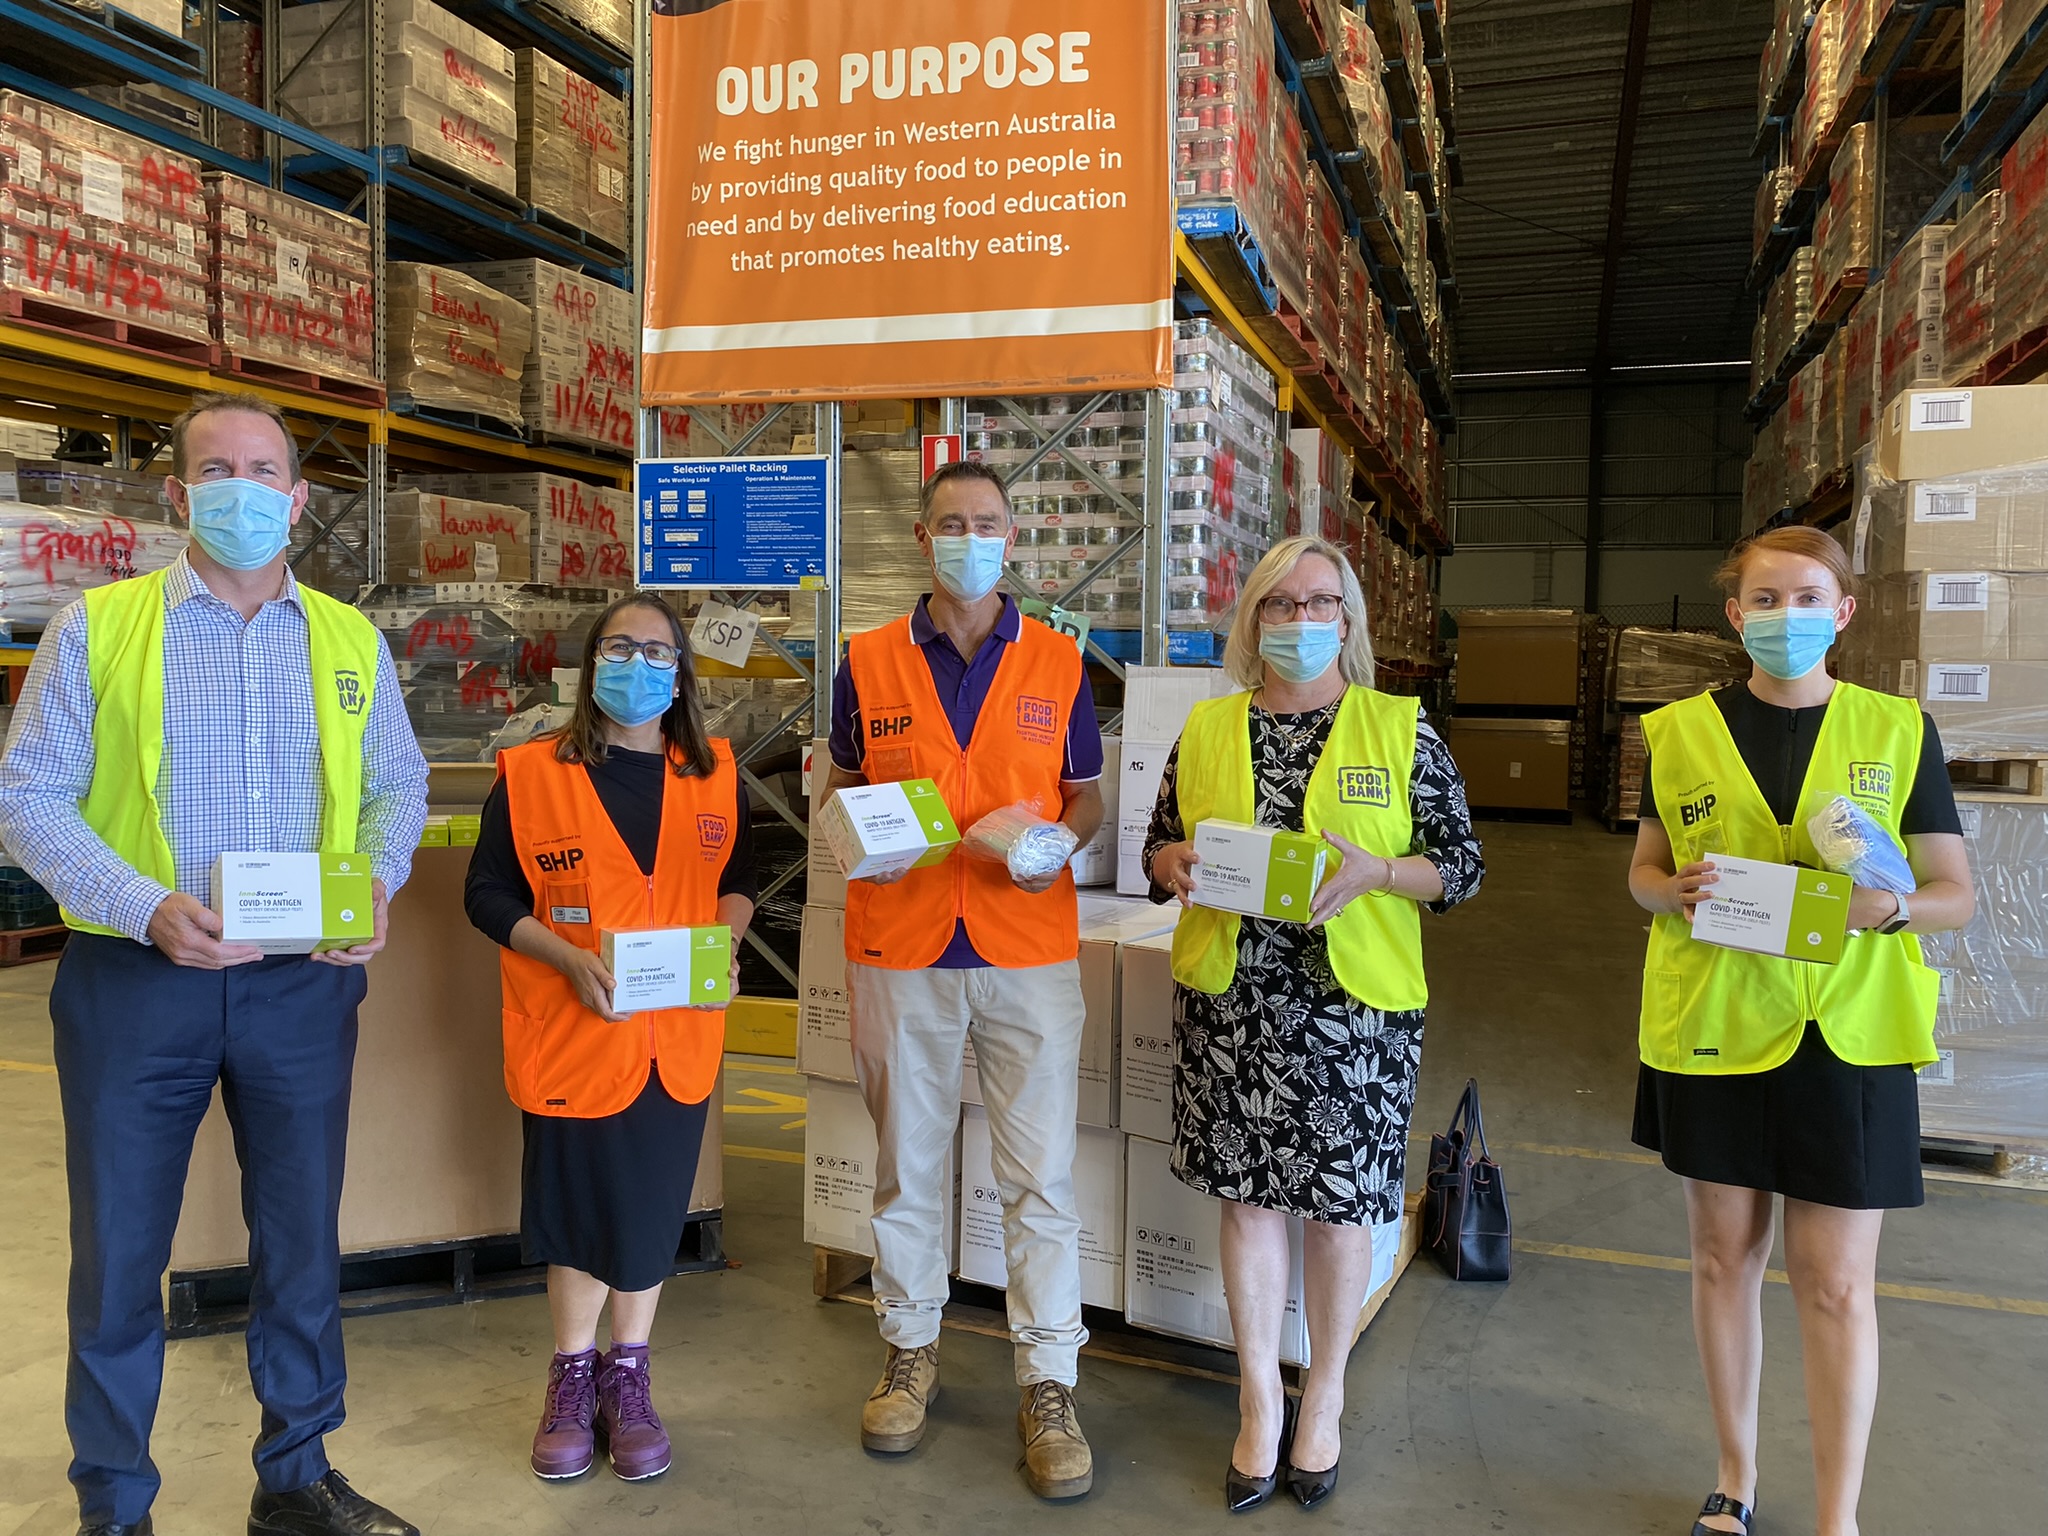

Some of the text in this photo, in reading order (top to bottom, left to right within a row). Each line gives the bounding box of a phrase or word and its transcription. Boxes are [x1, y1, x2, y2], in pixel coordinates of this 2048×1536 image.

[717, 32, 1091, 115] OUR PURPOSE
[698, 108, 1117, 165] We fight hunger in Western Australia
[691, 148, 1122, 203] by providing quality food to people in
[687, 188, 1126, 237] need and by delivering food education
[731, 231, 1070, 272] that promotes healthy eating.
[673, 463, 788, 474] Selective Pallet Racking
[702, 617, 743, 648] KSP
[1024, 702, 1052, 716] FOOD
[870, 716, 912, 738] BHP
[1024, 713, 1052, 727] BANK
[1129, 761, 1144, 771] AG
[1346, 772, 1382, 786] FOOD
[1858, 768, 1890, 784] FOOD
[1347, 785, 1384, 800] BANK
[1859, 779, 1890, 797] BANK
[1680, 794, 1716, 826] BHP
[703, 820, 724, 832] FOOD
[864, 818, 906, 829] COVID-19 ANTIGEN
[535, 848, 584, 872] BHP
[1202, 869, 1251, 884] COVID-19 ANTIGEN
[239, 899, 302, 907] COVID-19 ANTIGEN
[1710, 902, 1771, 920] COVID-19 ANTIGEN
[627, 973, 675, 983] COVID-19 ANTIGEN
